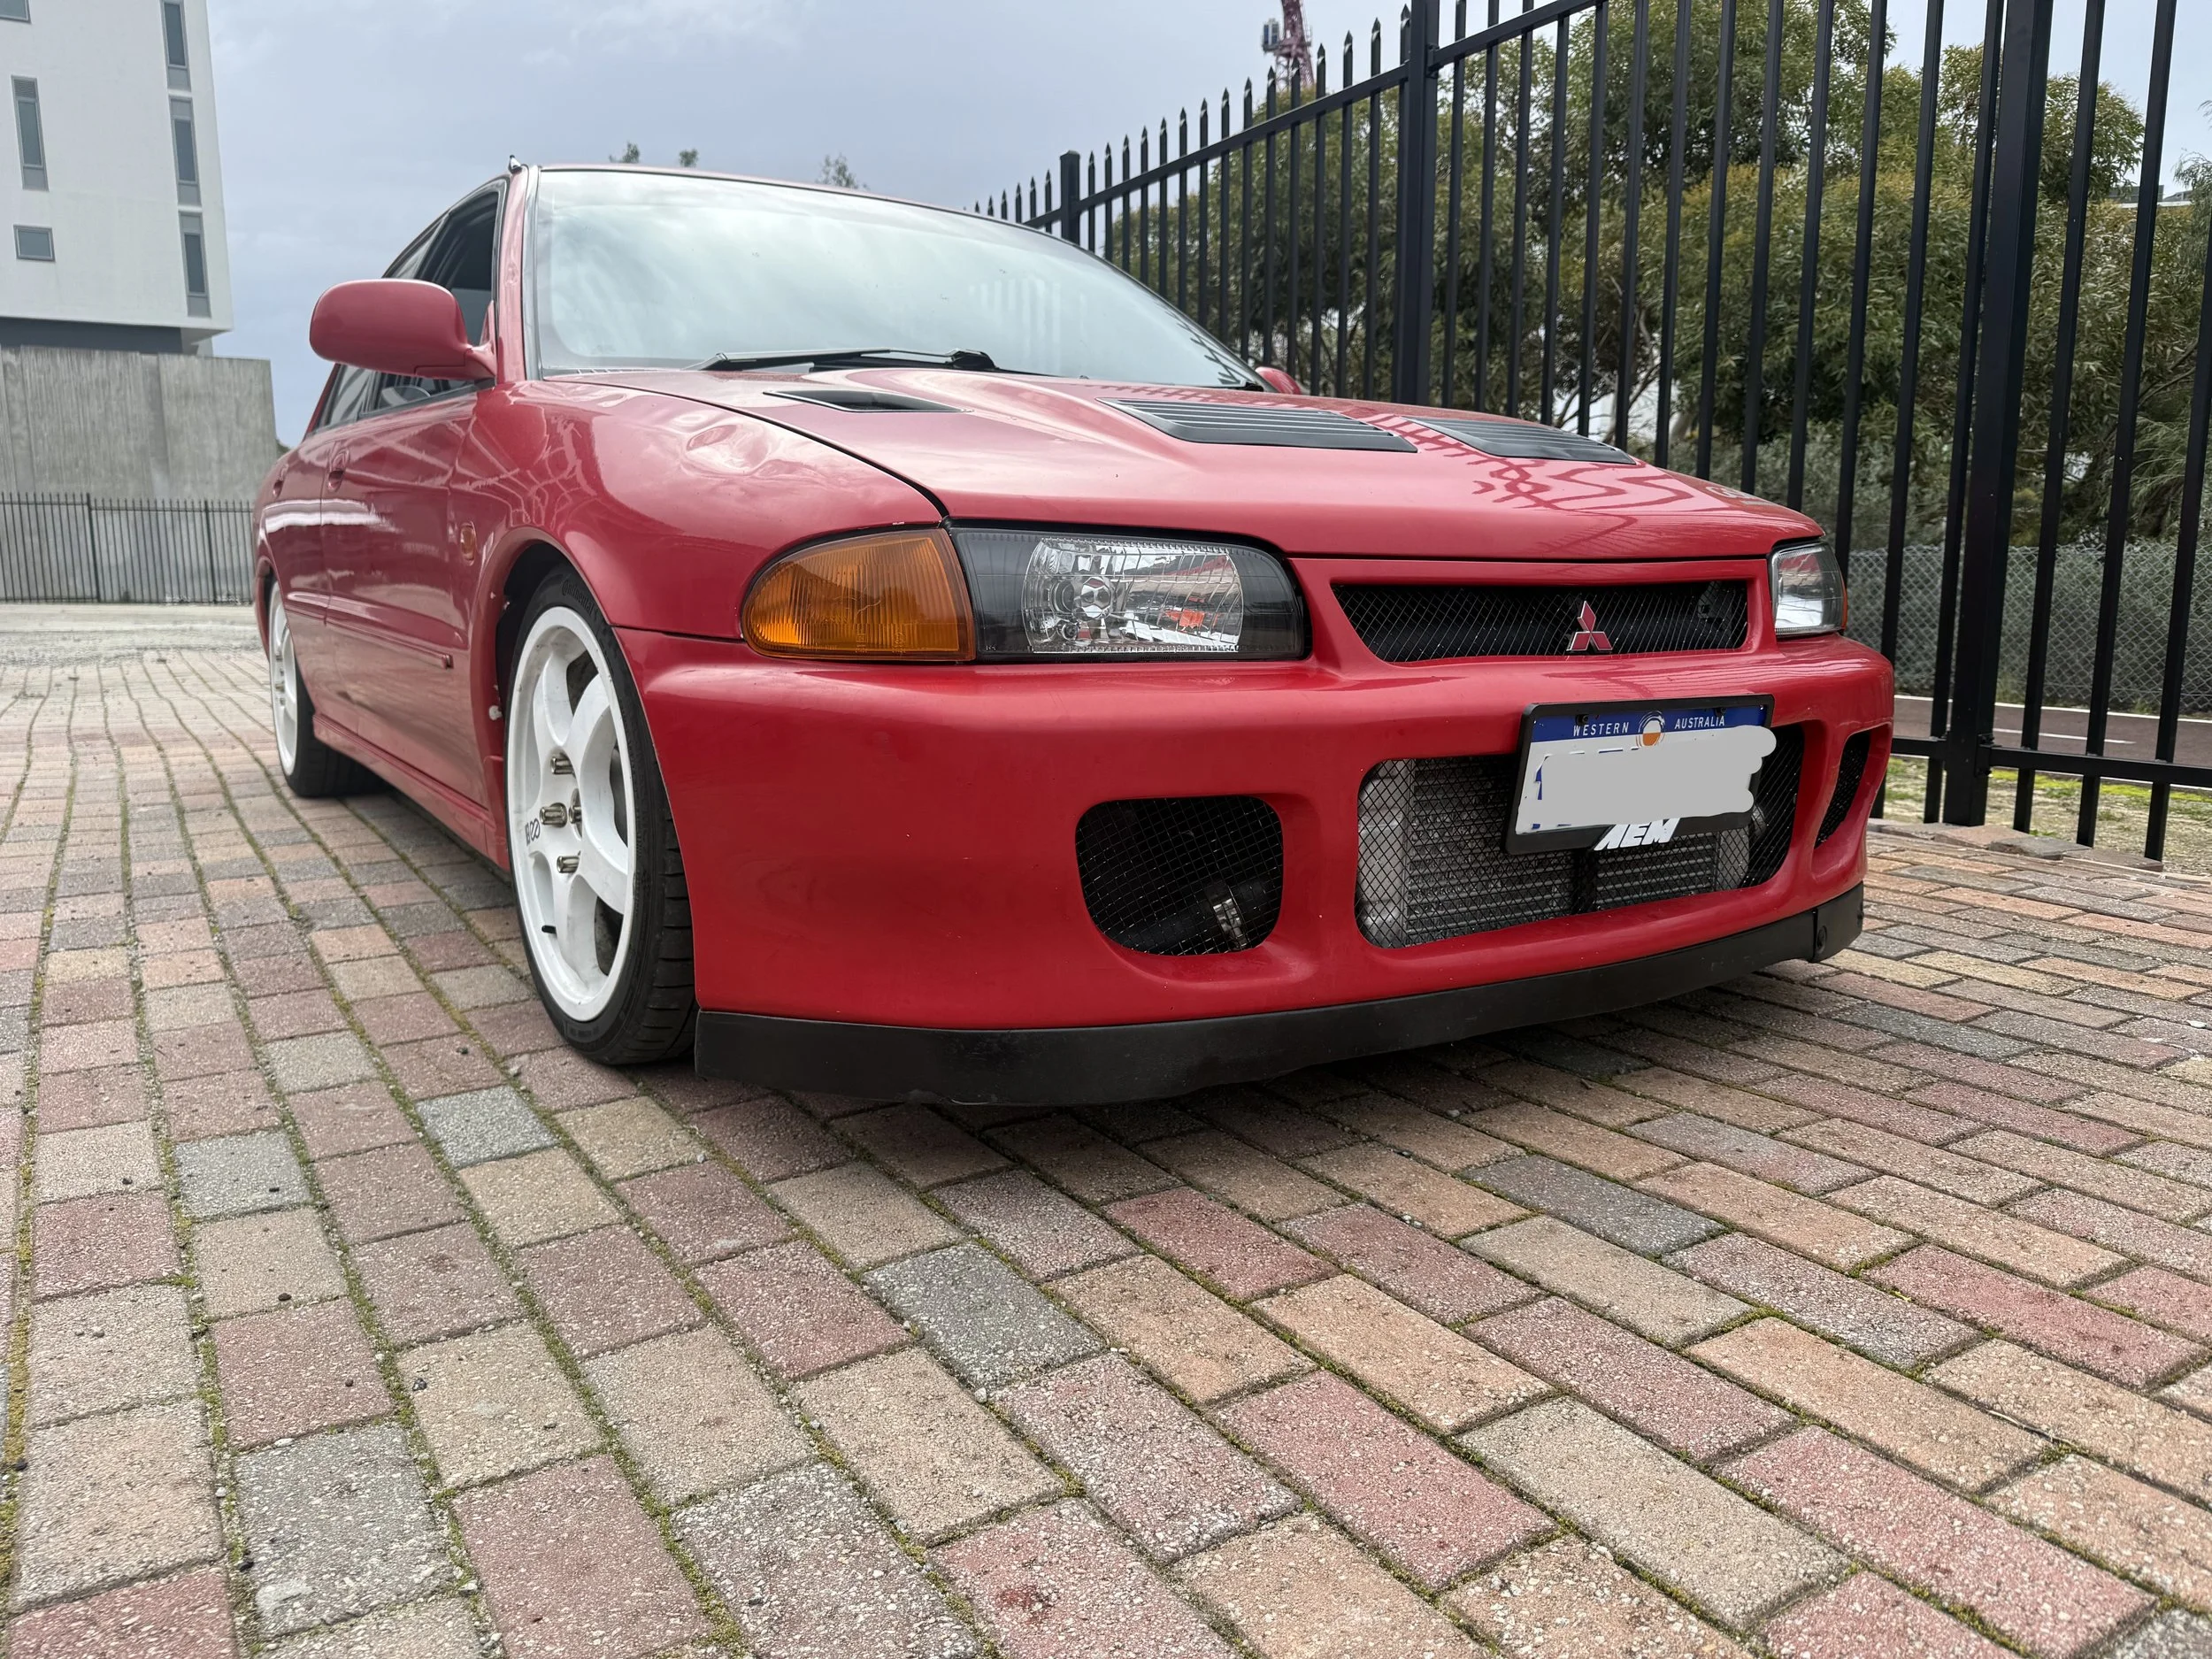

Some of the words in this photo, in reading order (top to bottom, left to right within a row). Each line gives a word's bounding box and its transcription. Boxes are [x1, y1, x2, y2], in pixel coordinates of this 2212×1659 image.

[1573, 722, 1629, 736] WESTERN
[1675, 716, 1724, 729] AUSTRALIA
[1594, 818, 1680, 850] AEM
